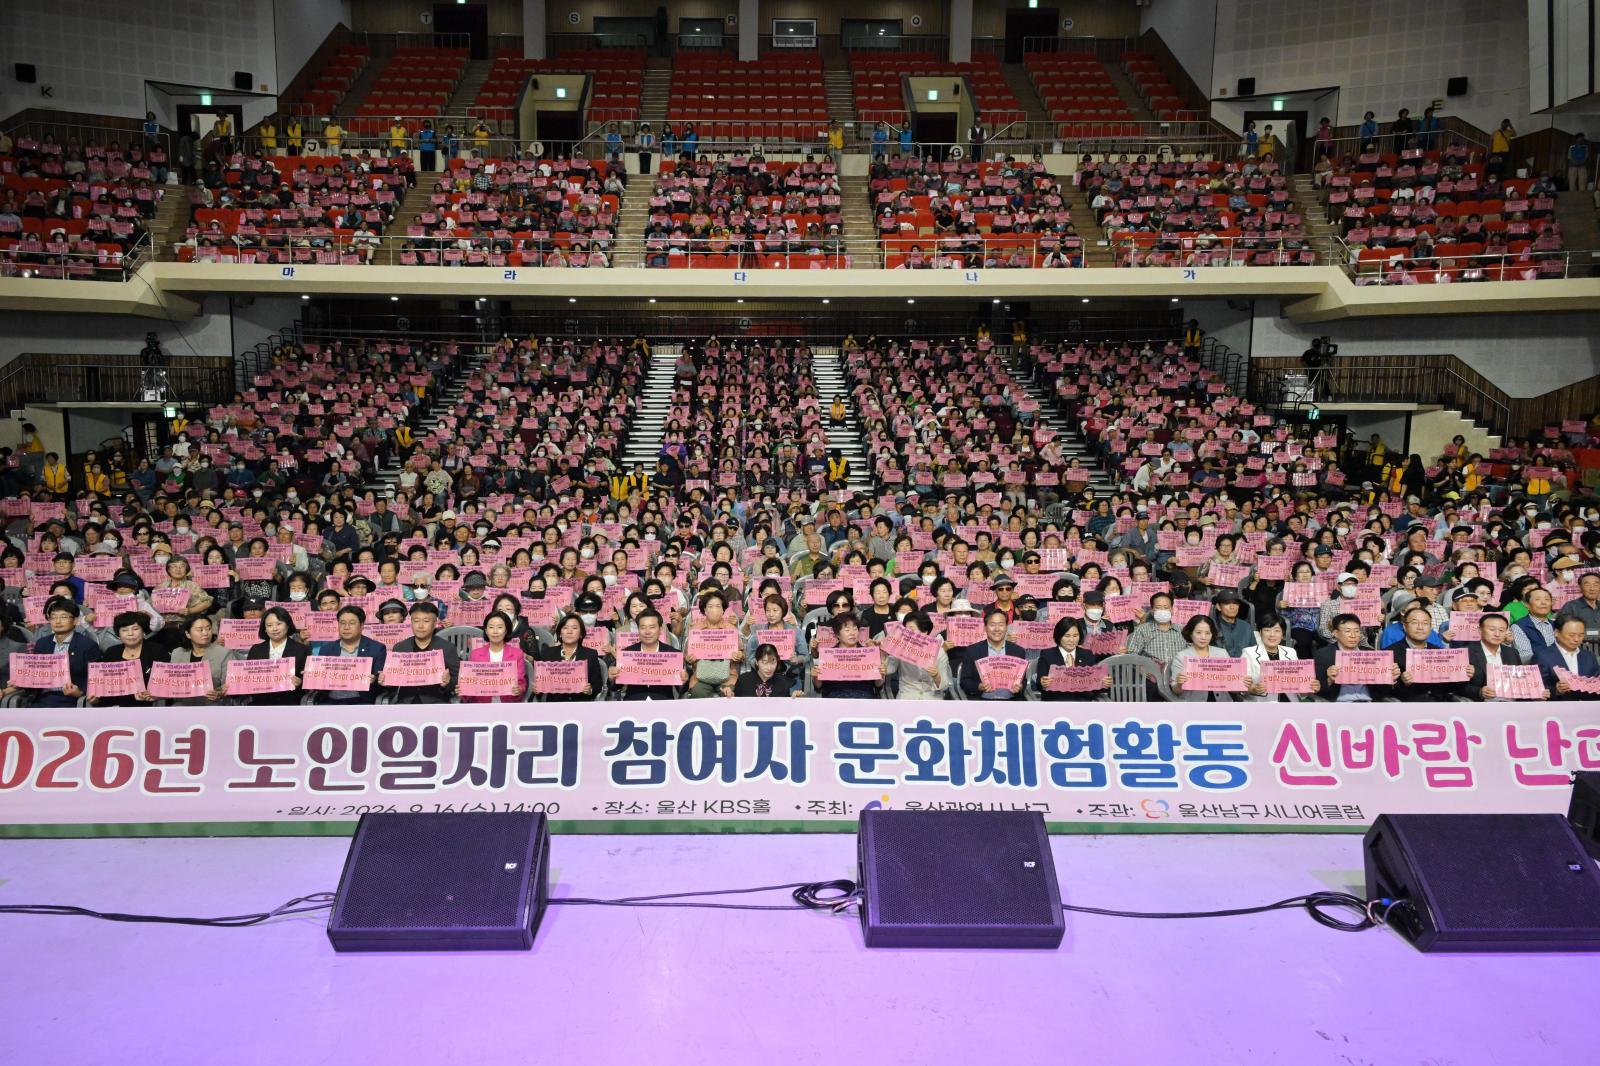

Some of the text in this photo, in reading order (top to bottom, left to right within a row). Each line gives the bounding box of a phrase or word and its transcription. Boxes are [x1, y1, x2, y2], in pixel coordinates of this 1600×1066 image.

[41, 86, 53, 97] K
[282, 266, 295, 277] 마
[504, 270, 517, 280] 라
[734, 271, 747, 281] 다
[966, 271, 979, 281] 나
[1183, 270, 1197, 280] 가
[228, 725, 578, 790] 노인일자리
[604, 721, 814, 785] 참여자
[837, 721, 1248, 787] 문화체험활동
[1273, 720, 1482, 787] 신바람
[288, 805, 336, 816] 일시:
[605, 799, 771, 815] 장소: 울산 KBS홀
[807, 800, 853, 815] 주최:
[1088, 803, 1136, 817] 주관:
